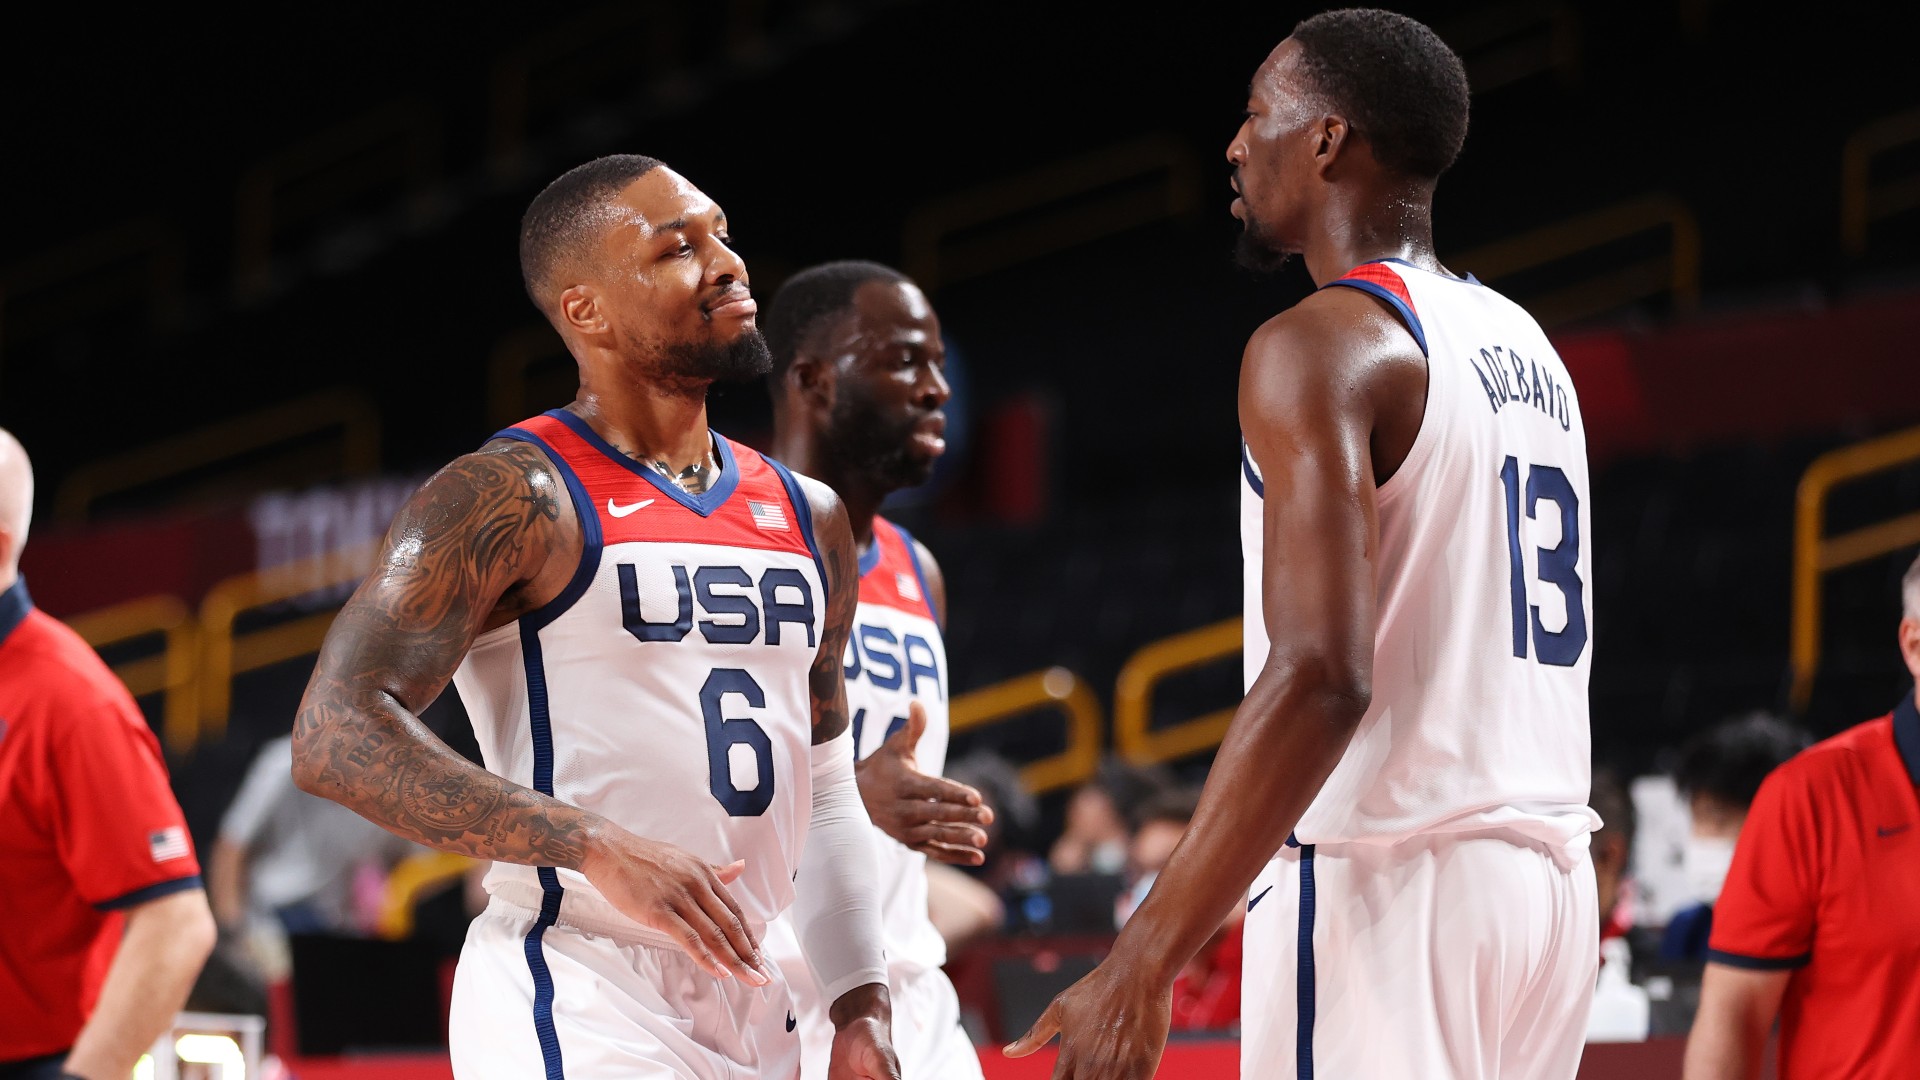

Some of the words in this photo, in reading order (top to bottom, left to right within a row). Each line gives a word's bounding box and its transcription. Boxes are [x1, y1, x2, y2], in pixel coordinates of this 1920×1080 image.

[1470, 345, 1570, 432] ADEBAYO
[617, 563, 815, 648] USA
[1500, 454, 1588, 667] 13
[699, 667, 775, 817] 6
